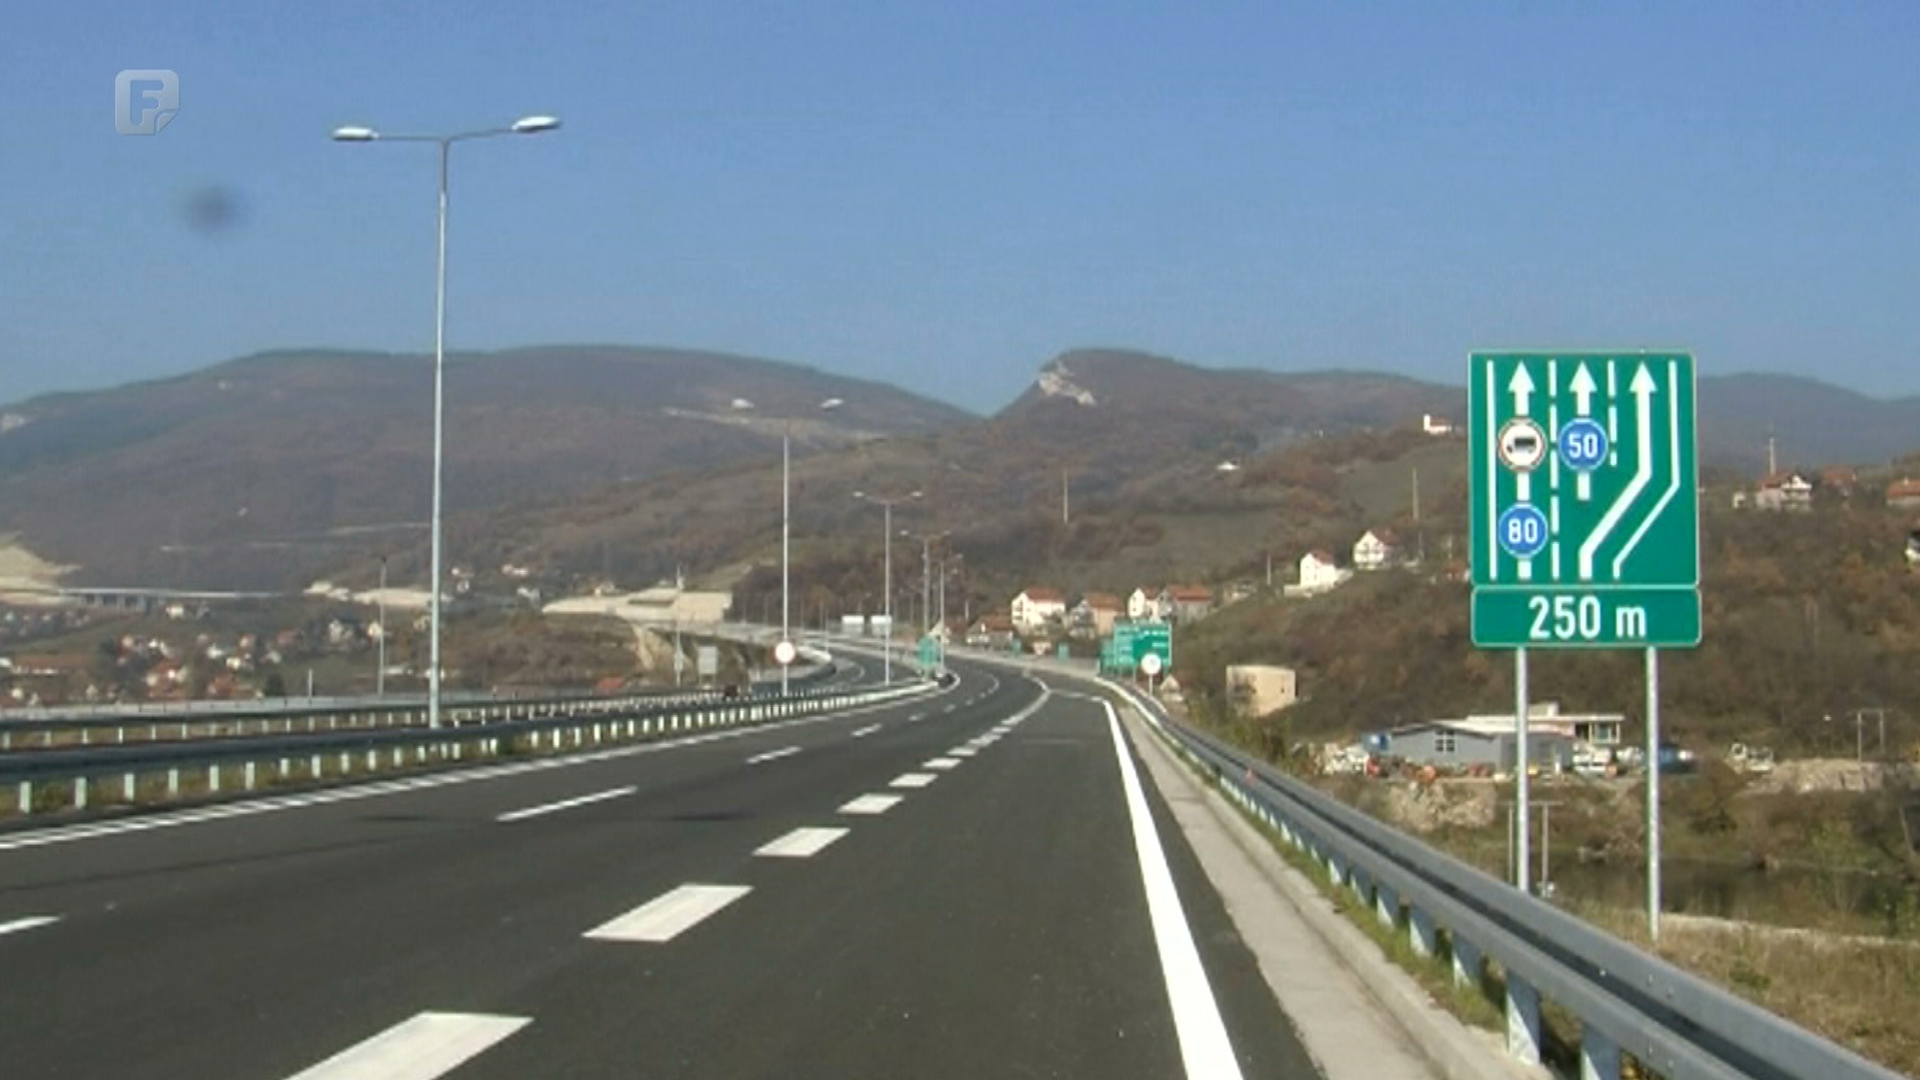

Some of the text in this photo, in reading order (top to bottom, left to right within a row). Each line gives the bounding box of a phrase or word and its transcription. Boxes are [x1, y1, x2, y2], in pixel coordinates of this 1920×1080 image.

[1568, 433, 1598, 458] 50
[1508, 518, 1538, 544] 80
[1528, 595, 1646, 639] 250 m
